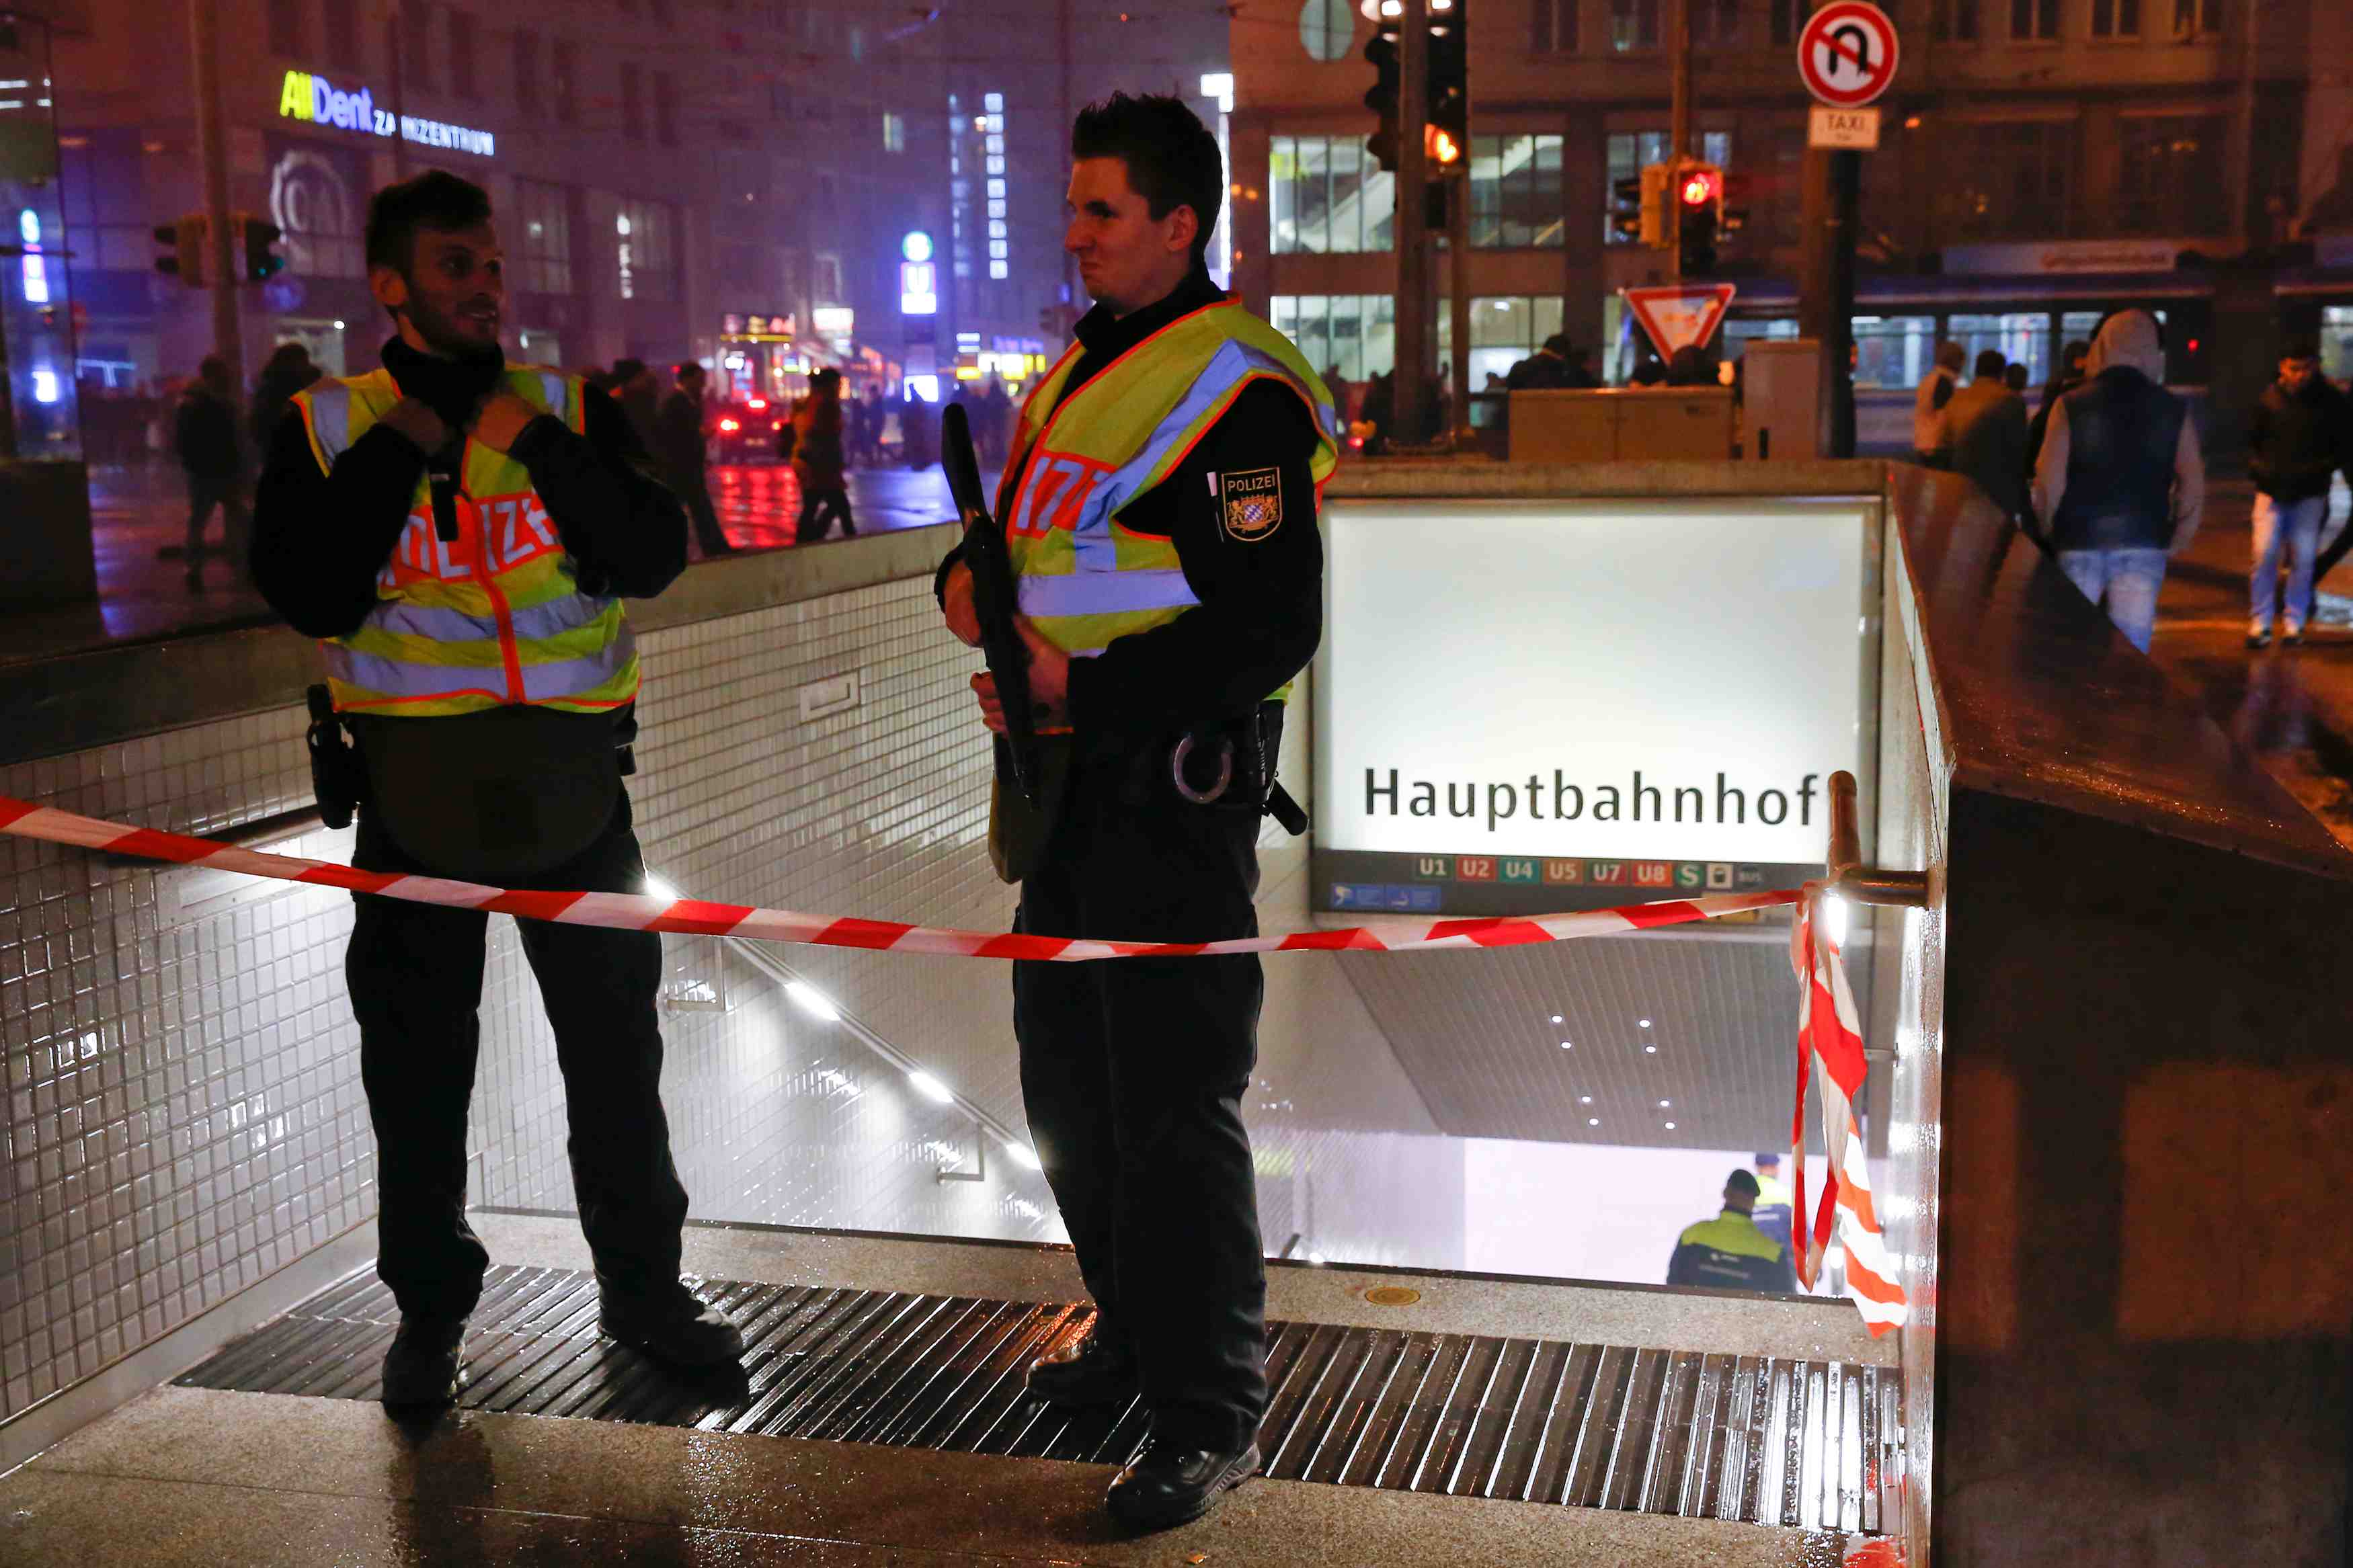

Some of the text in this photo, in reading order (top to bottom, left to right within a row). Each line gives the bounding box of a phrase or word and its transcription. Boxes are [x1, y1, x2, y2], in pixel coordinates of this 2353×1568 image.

[280, 70, 374, 134] AllDent
[1827, 115, 1865, 130] TAXI
[1228, 474, 1275, 492] POLIZEI
[1365, 768, 1818, 831] Hauptbahnhof
[1420, 858, 1447, 875] U1
[1462, 860, 1490, 877] U2
[1505, 862, 1533, 879] U4
[1549, 862, 1577, 880] U5
[1593, 864, 1621, 881] U7
[1637, 864, 1665, 882] U8
[1681, 864, 1700, 886] S
